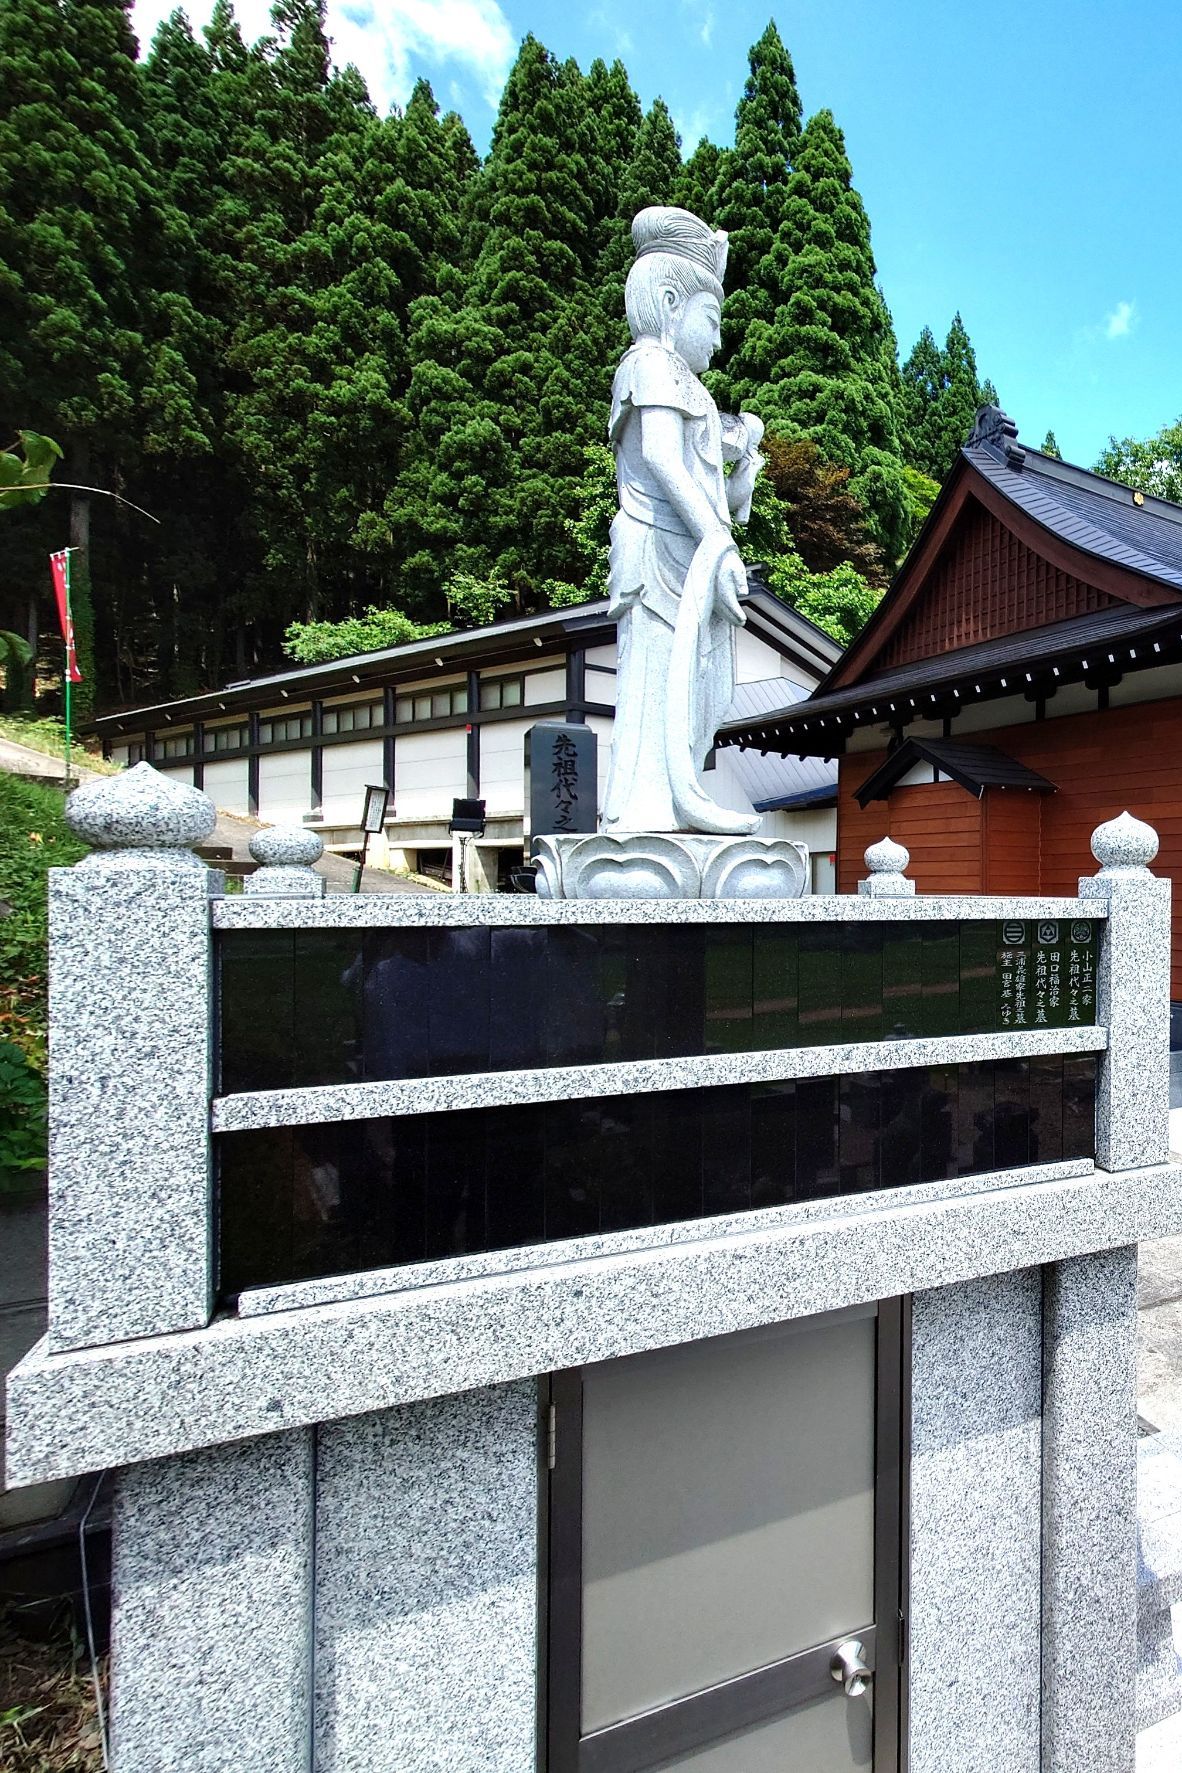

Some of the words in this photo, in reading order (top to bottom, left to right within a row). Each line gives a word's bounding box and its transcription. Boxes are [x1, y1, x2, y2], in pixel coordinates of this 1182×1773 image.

[550, 734, 578, 831] 先祖代々之
[1035, 951, 1047, 1023] 先祖代々之墓
[1049, 952, 1060, 1007] 田口福治家
[1068, 950, 1080, 1020] 先祖代々之墓
[1082, 951, 1093, 1005] 小山正二家
